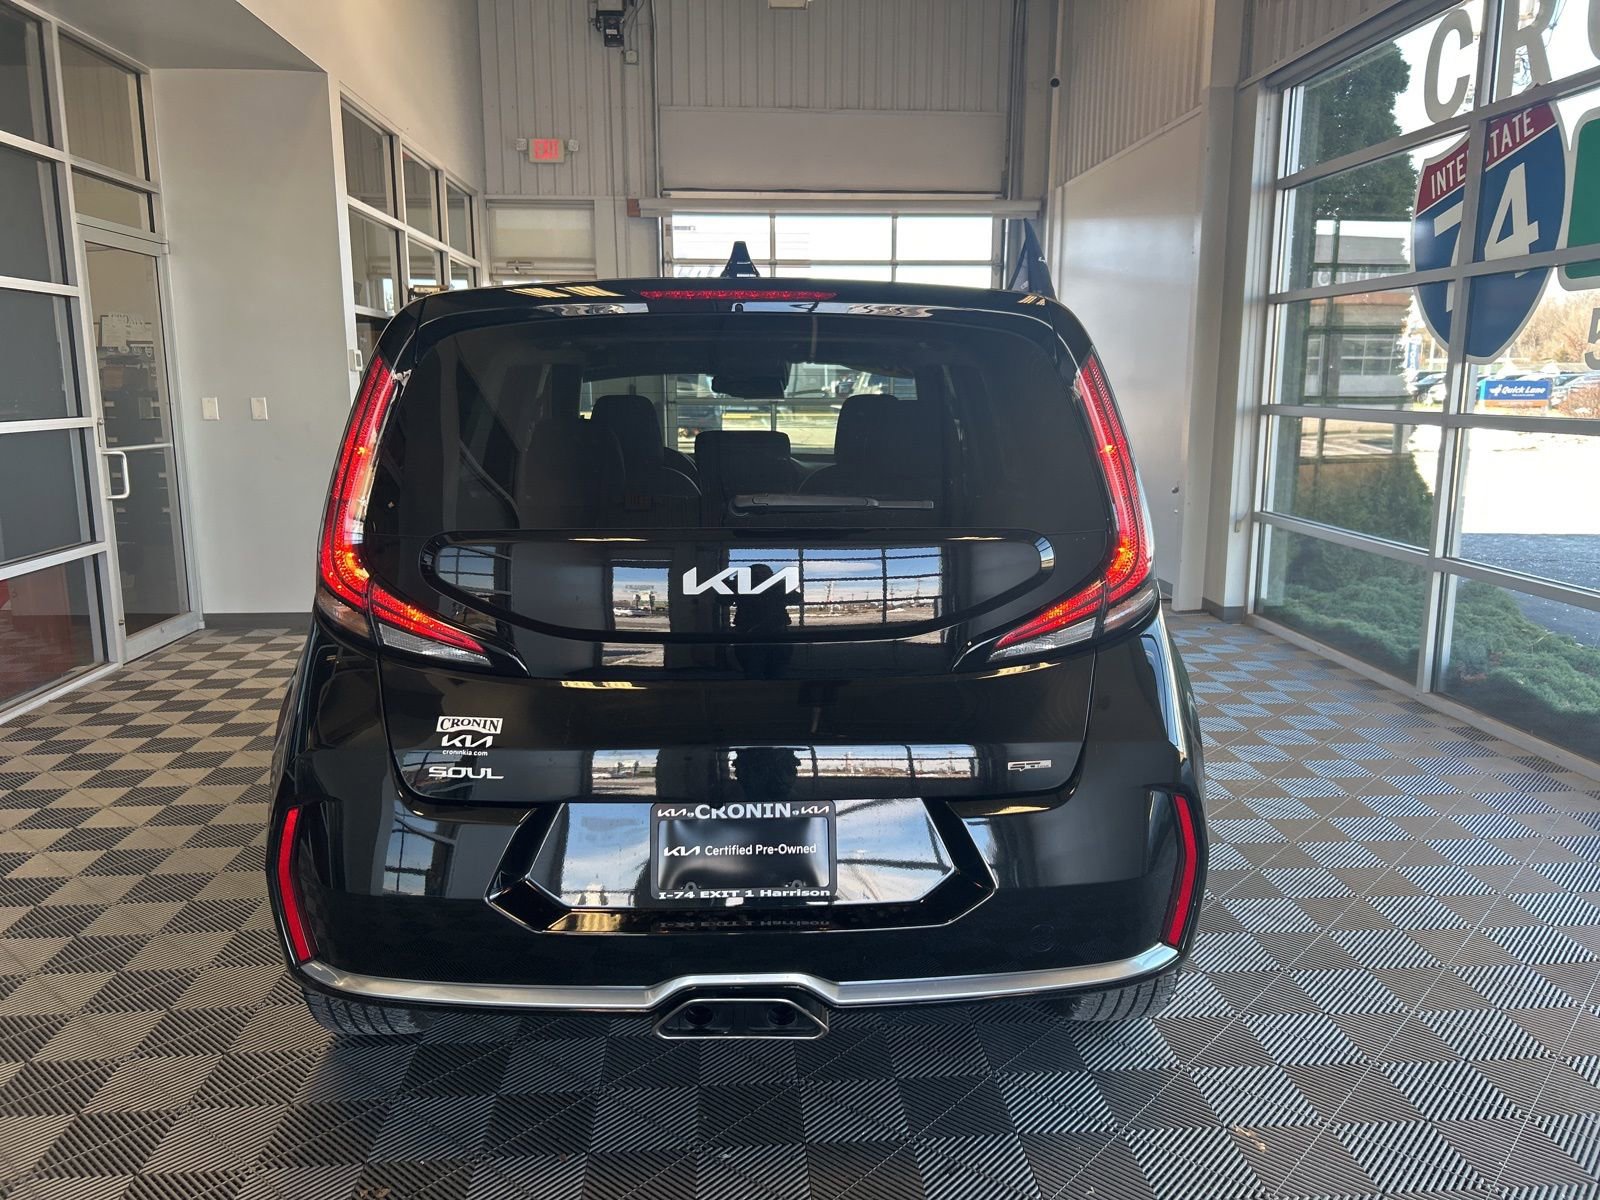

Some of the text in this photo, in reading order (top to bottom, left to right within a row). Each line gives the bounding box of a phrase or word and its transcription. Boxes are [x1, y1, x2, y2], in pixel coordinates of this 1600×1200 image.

[1424, 0, 1600, 124] CR
[1431, 107, 1536, 199] INTETATE
[1502, 386, 1546, 394] Quick Lane
[682, 566, 800, 595] KIA
[440, 718, 499, 732] CRONIN
[441, 734, 493, 748] KIA
[428, 766, 504, 780] SOUL
[657, 803, 830, 819] KIA CRONIN KIA
[663, 843, 817, 857] KIA Certified Pre-Owned
[658, 888, 831, 900] I-74 EXIT 1 Harrison
